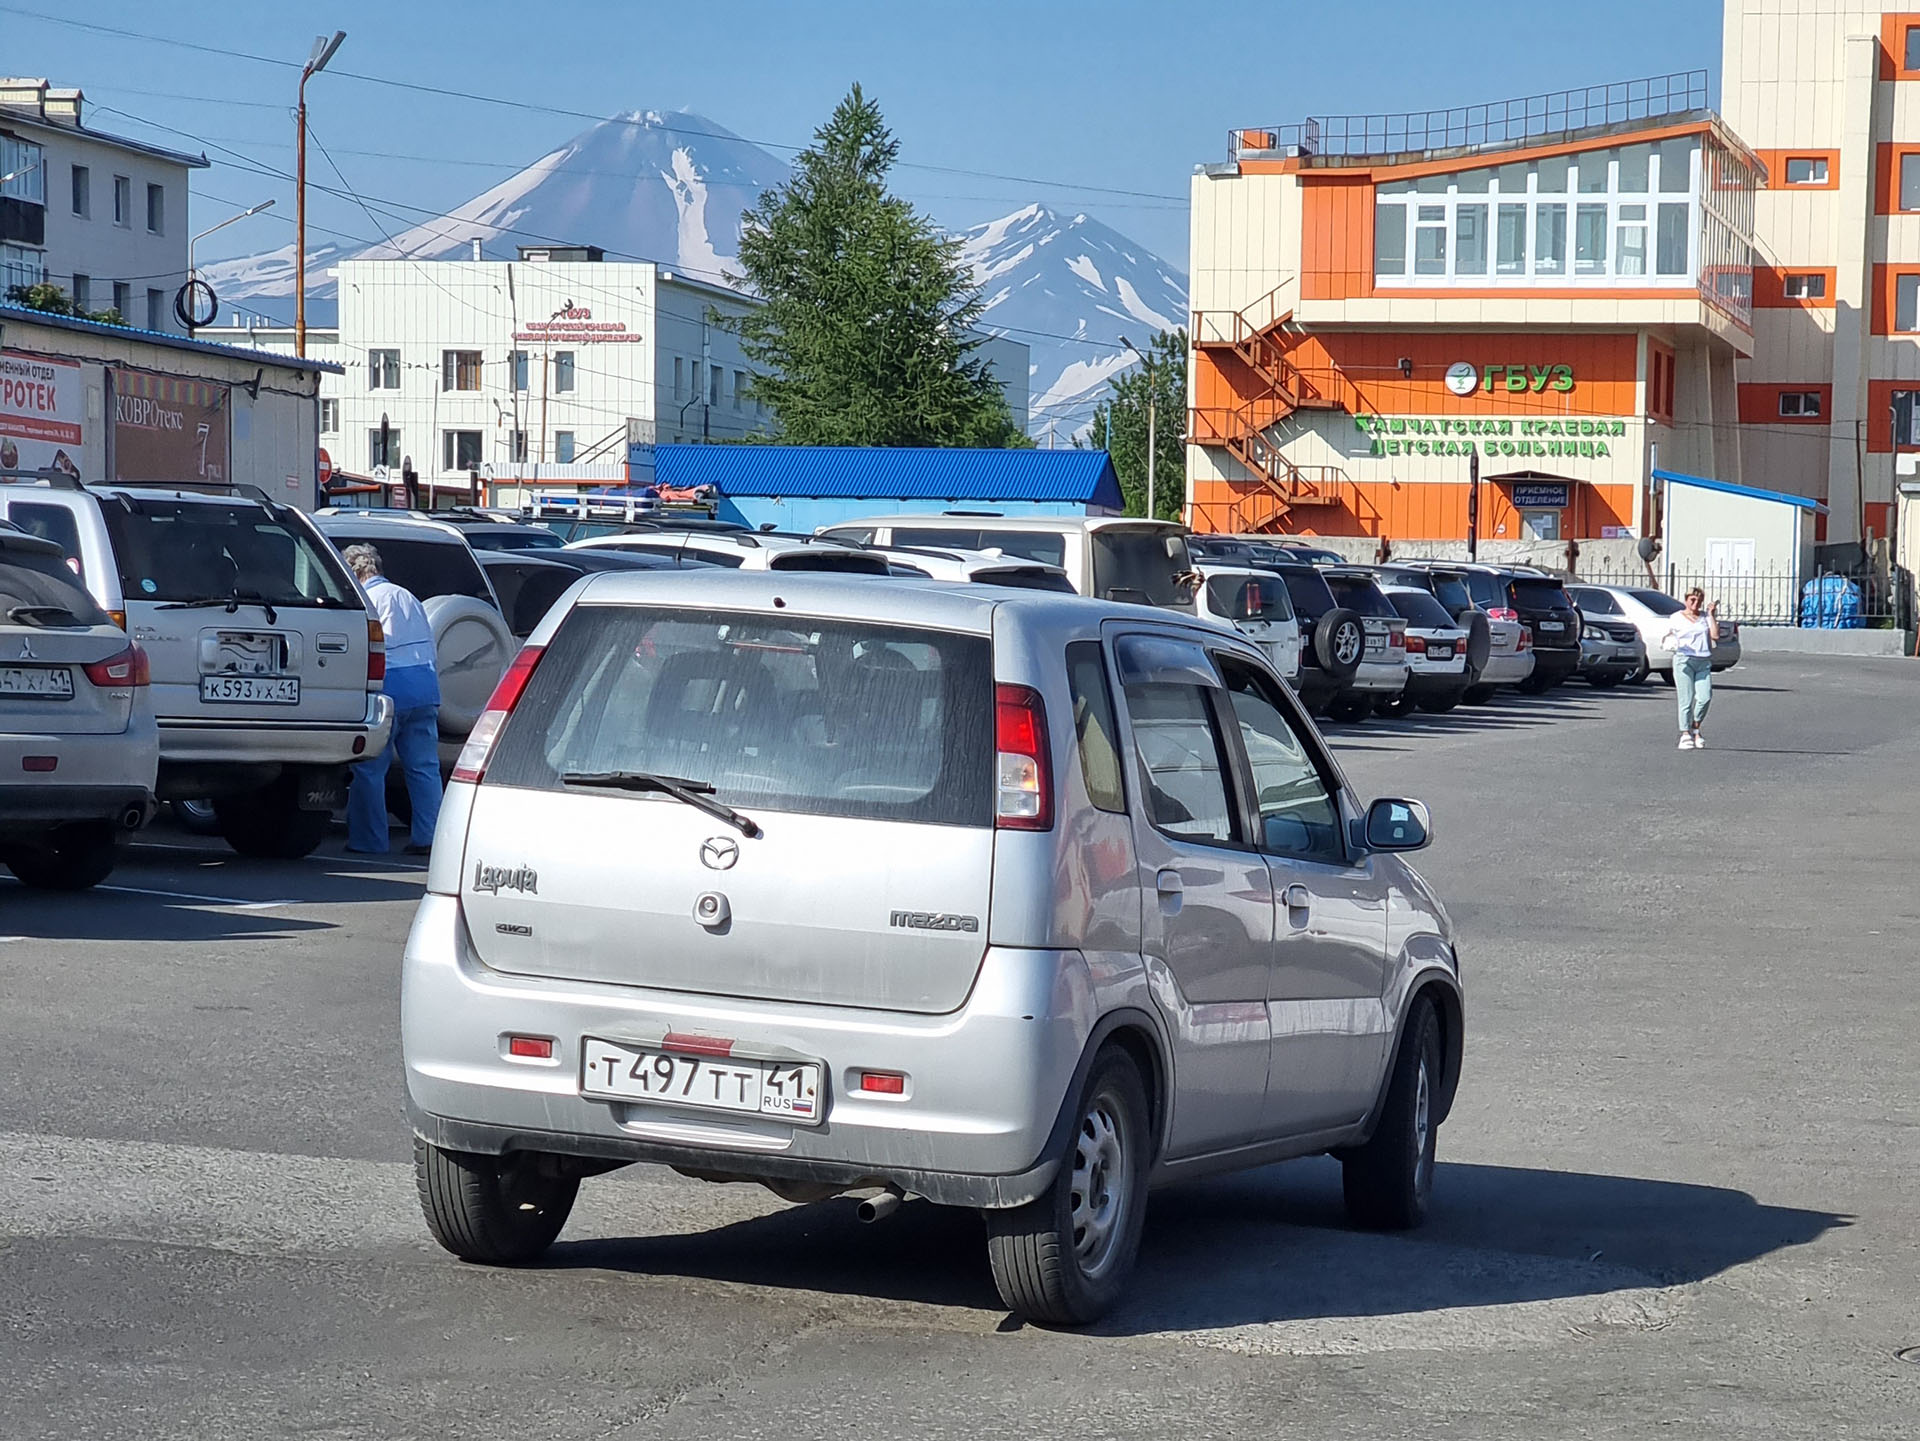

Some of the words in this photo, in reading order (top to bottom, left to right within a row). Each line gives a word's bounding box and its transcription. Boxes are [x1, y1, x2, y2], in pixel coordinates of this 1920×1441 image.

[32, 366, 56, 381] ОТДЕЛ
[1483, 364, 1573, 391] ГБУЗ
[1355, 413, 1512, 435] КАМЧАТСКАЯ
[1521, 420, 1624, 436] КРАЕВАЯ
[1484, 440, 1610, 459] БОЛЬНИЦА
[1514, 495, 1566, 505] ОТДЕЛЕНИЕ
[279, 681, 294, 695] 41
[766, 1065, 803, 1098] 41
[763, 1096, 791, 1109] RUS
